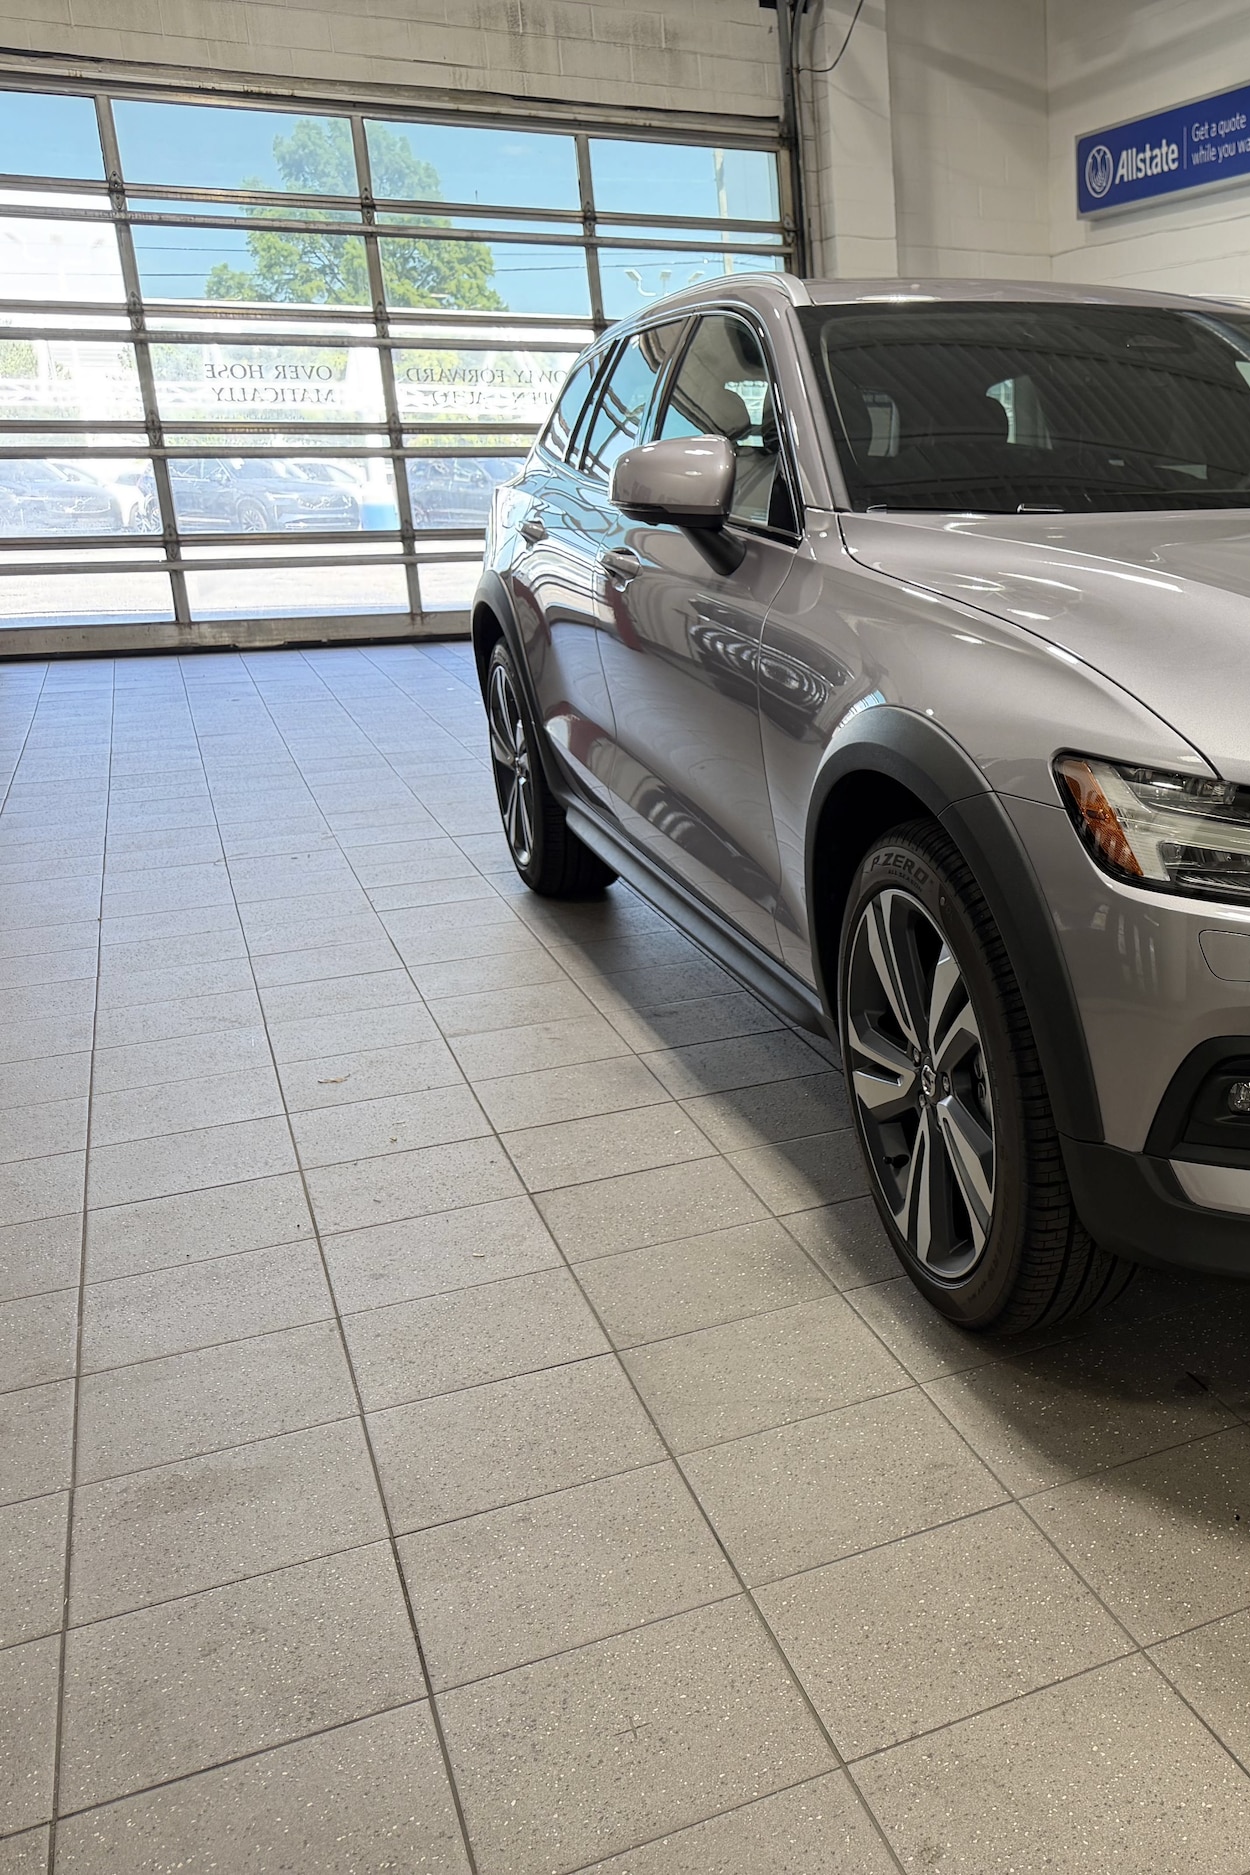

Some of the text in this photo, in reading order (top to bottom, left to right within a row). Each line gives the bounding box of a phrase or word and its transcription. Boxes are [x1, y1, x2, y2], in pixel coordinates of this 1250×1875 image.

[1191, 113, 1247, 142] Get a quote
[1115, 138, 1179, 185] Allstate
[1191, 146, 1217, 165] while
[1217, 140, 1236, 163] you
[881, 852, 930, 885] ZERO
